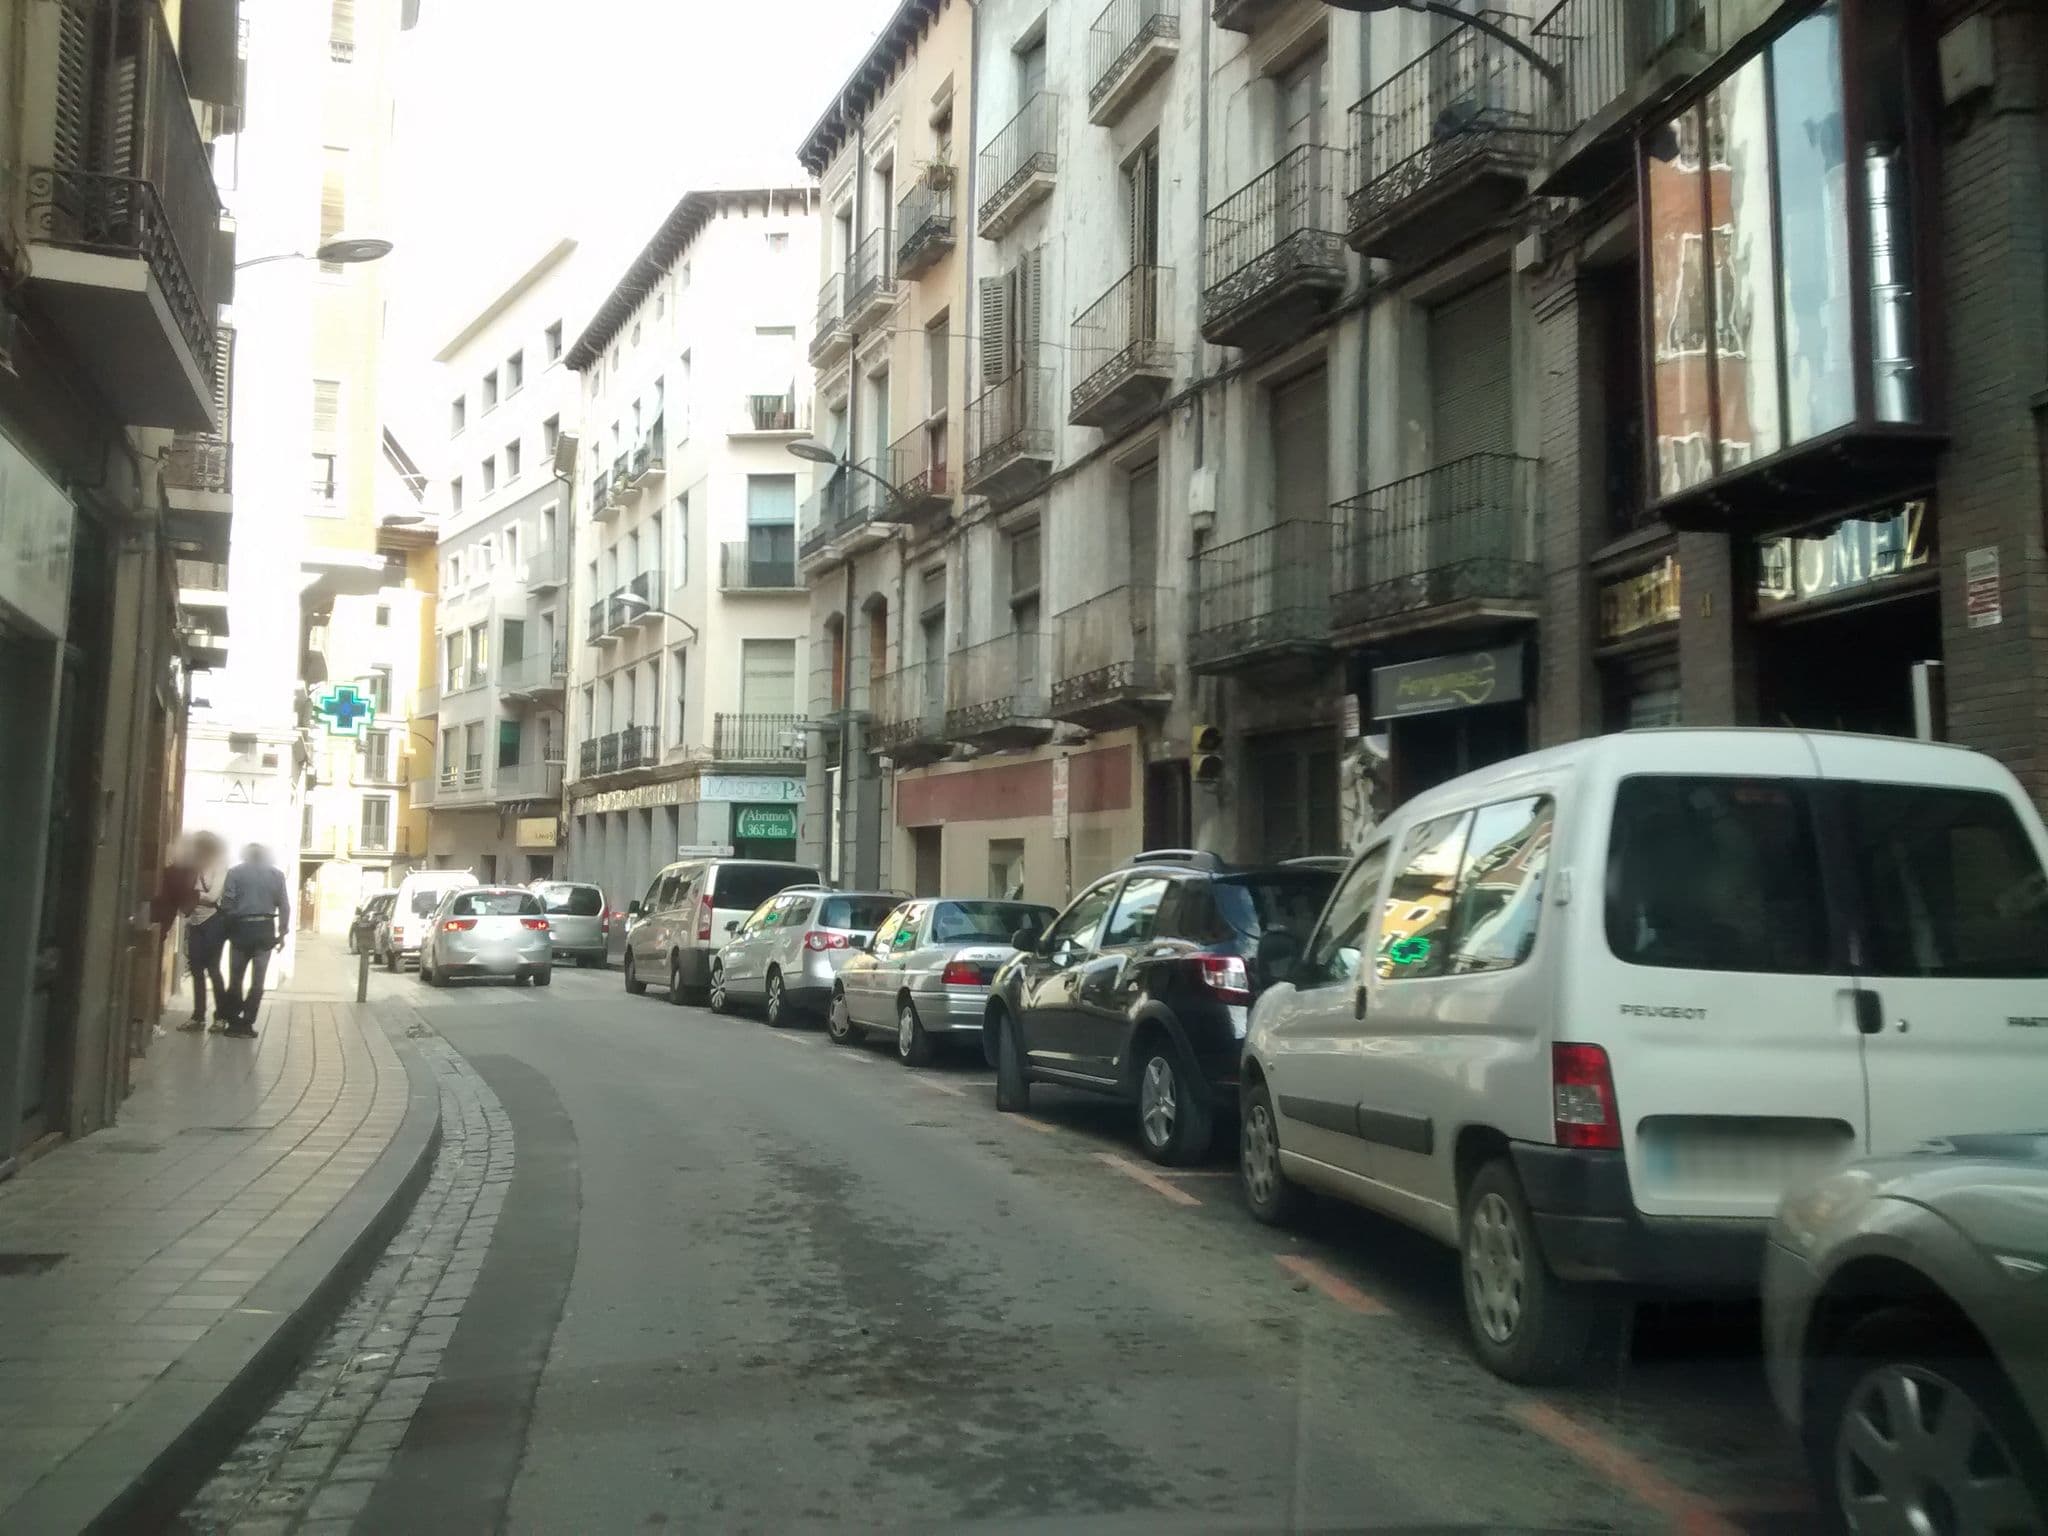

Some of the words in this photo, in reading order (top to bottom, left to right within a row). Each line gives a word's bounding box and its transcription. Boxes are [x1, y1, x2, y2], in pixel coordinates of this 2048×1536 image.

[747, 809, 789, 822] Abrimos
[747, 824, 765, 836] 365
[1620, 1004, 1707, 1020] PEUGEOT
